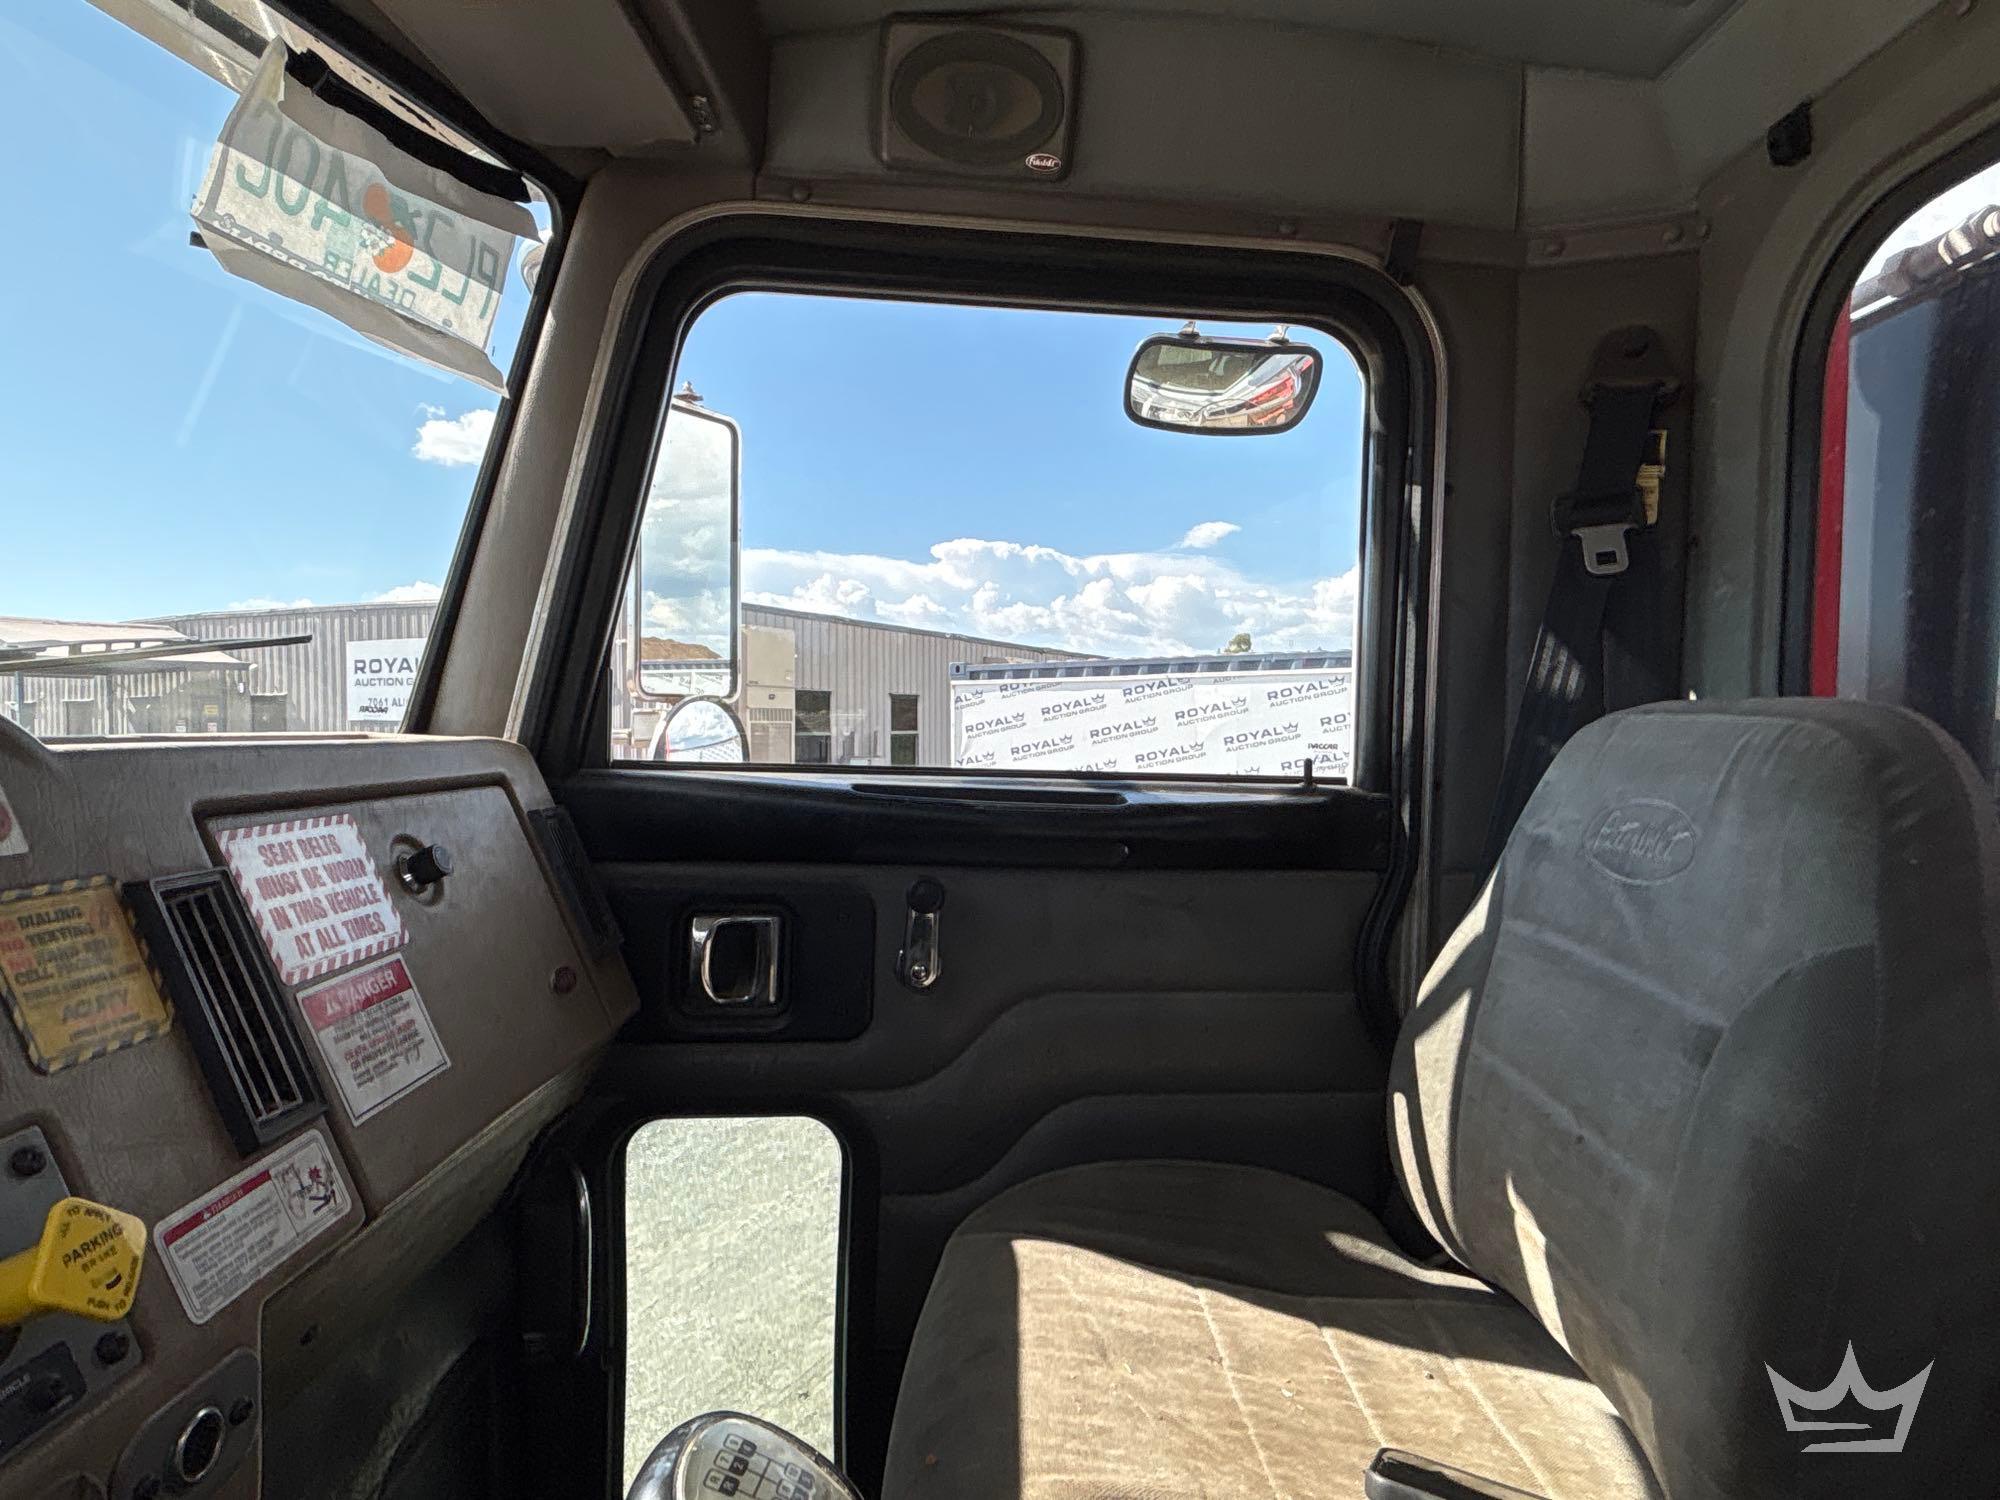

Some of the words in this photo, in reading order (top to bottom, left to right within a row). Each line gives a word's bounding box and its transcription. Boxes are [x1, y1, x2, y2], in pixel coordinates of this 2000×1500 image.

[355, 677, 403, 686] AUCTION
[1123, 678, 1177, 697] ROYAL
[1267, 680, 1329, 701] ROYAL
[1001, 687, 1034, 699] AUCTION
[1125, 691, 1162, 704] AUCTION
[1163, 684, 1193, 695] GROUP
[1269, 694, 1312, 708] AUCTION
[1313, 687, 1348, 699] GROUP
[1041, 697, 1088, 716] ROYAL
[1043, 709, 1078, 722] AUCTION
[1079, 704, 1107, 715] GROUP
[1175, 702, 1231, 720] ROYAL
[965, 716, 1012, 733] ROYAL
[1177, 715, 1217, 727] AUCTION
[1218, 707, 1249, 720] GROUP
[967, 727, 999, 739] AUCTION
[1001, 722, 1027, 731] GROUP
[1090, 720, 1142, 739] ROYAL
[1092, 734, 1128, 745] AUCTION
[1129, 727, 1158, 738] GROUP
[1223, 726, 1279, 746] ROYAL
[1011, 739, 1059, 756] ROYAL
[1226, 740, 1267, 752] AUCTION
[1268, 733, 1301, 744] GROUP
[1012, 749, 1046, 761] AUCTION
[1047, 744, 1075, 755] GROUP
[1135, 745, 1190, 763] ROYAL
[1137, 758, 1174, 769] AUCTION
[1175, 752, 1206, 762] GROUP
[257, 840, 299, 867] SEAT
[296, 833, 342, 860] BELTS
[256, 870, 303, 901] MUST
[301, 866, 327, 889] BE
[323, 857, 368, 884] WORN
[269, 906, 293, 931] IN
[290, 897, 328, 926] THIS
[326, 883, 382, 915] VEHICLE
[17, 906, 83, 930] DIALING
[25, 923, 95, 946] TEXTING
[295, 932, 316, 959] AT
[316, 924, 346, 951] ALL
[341, 911, 386, 942] TIMES
[338, 968, 397, 1010] DANGER
[62, 1222, 124, 1270] PARKING
